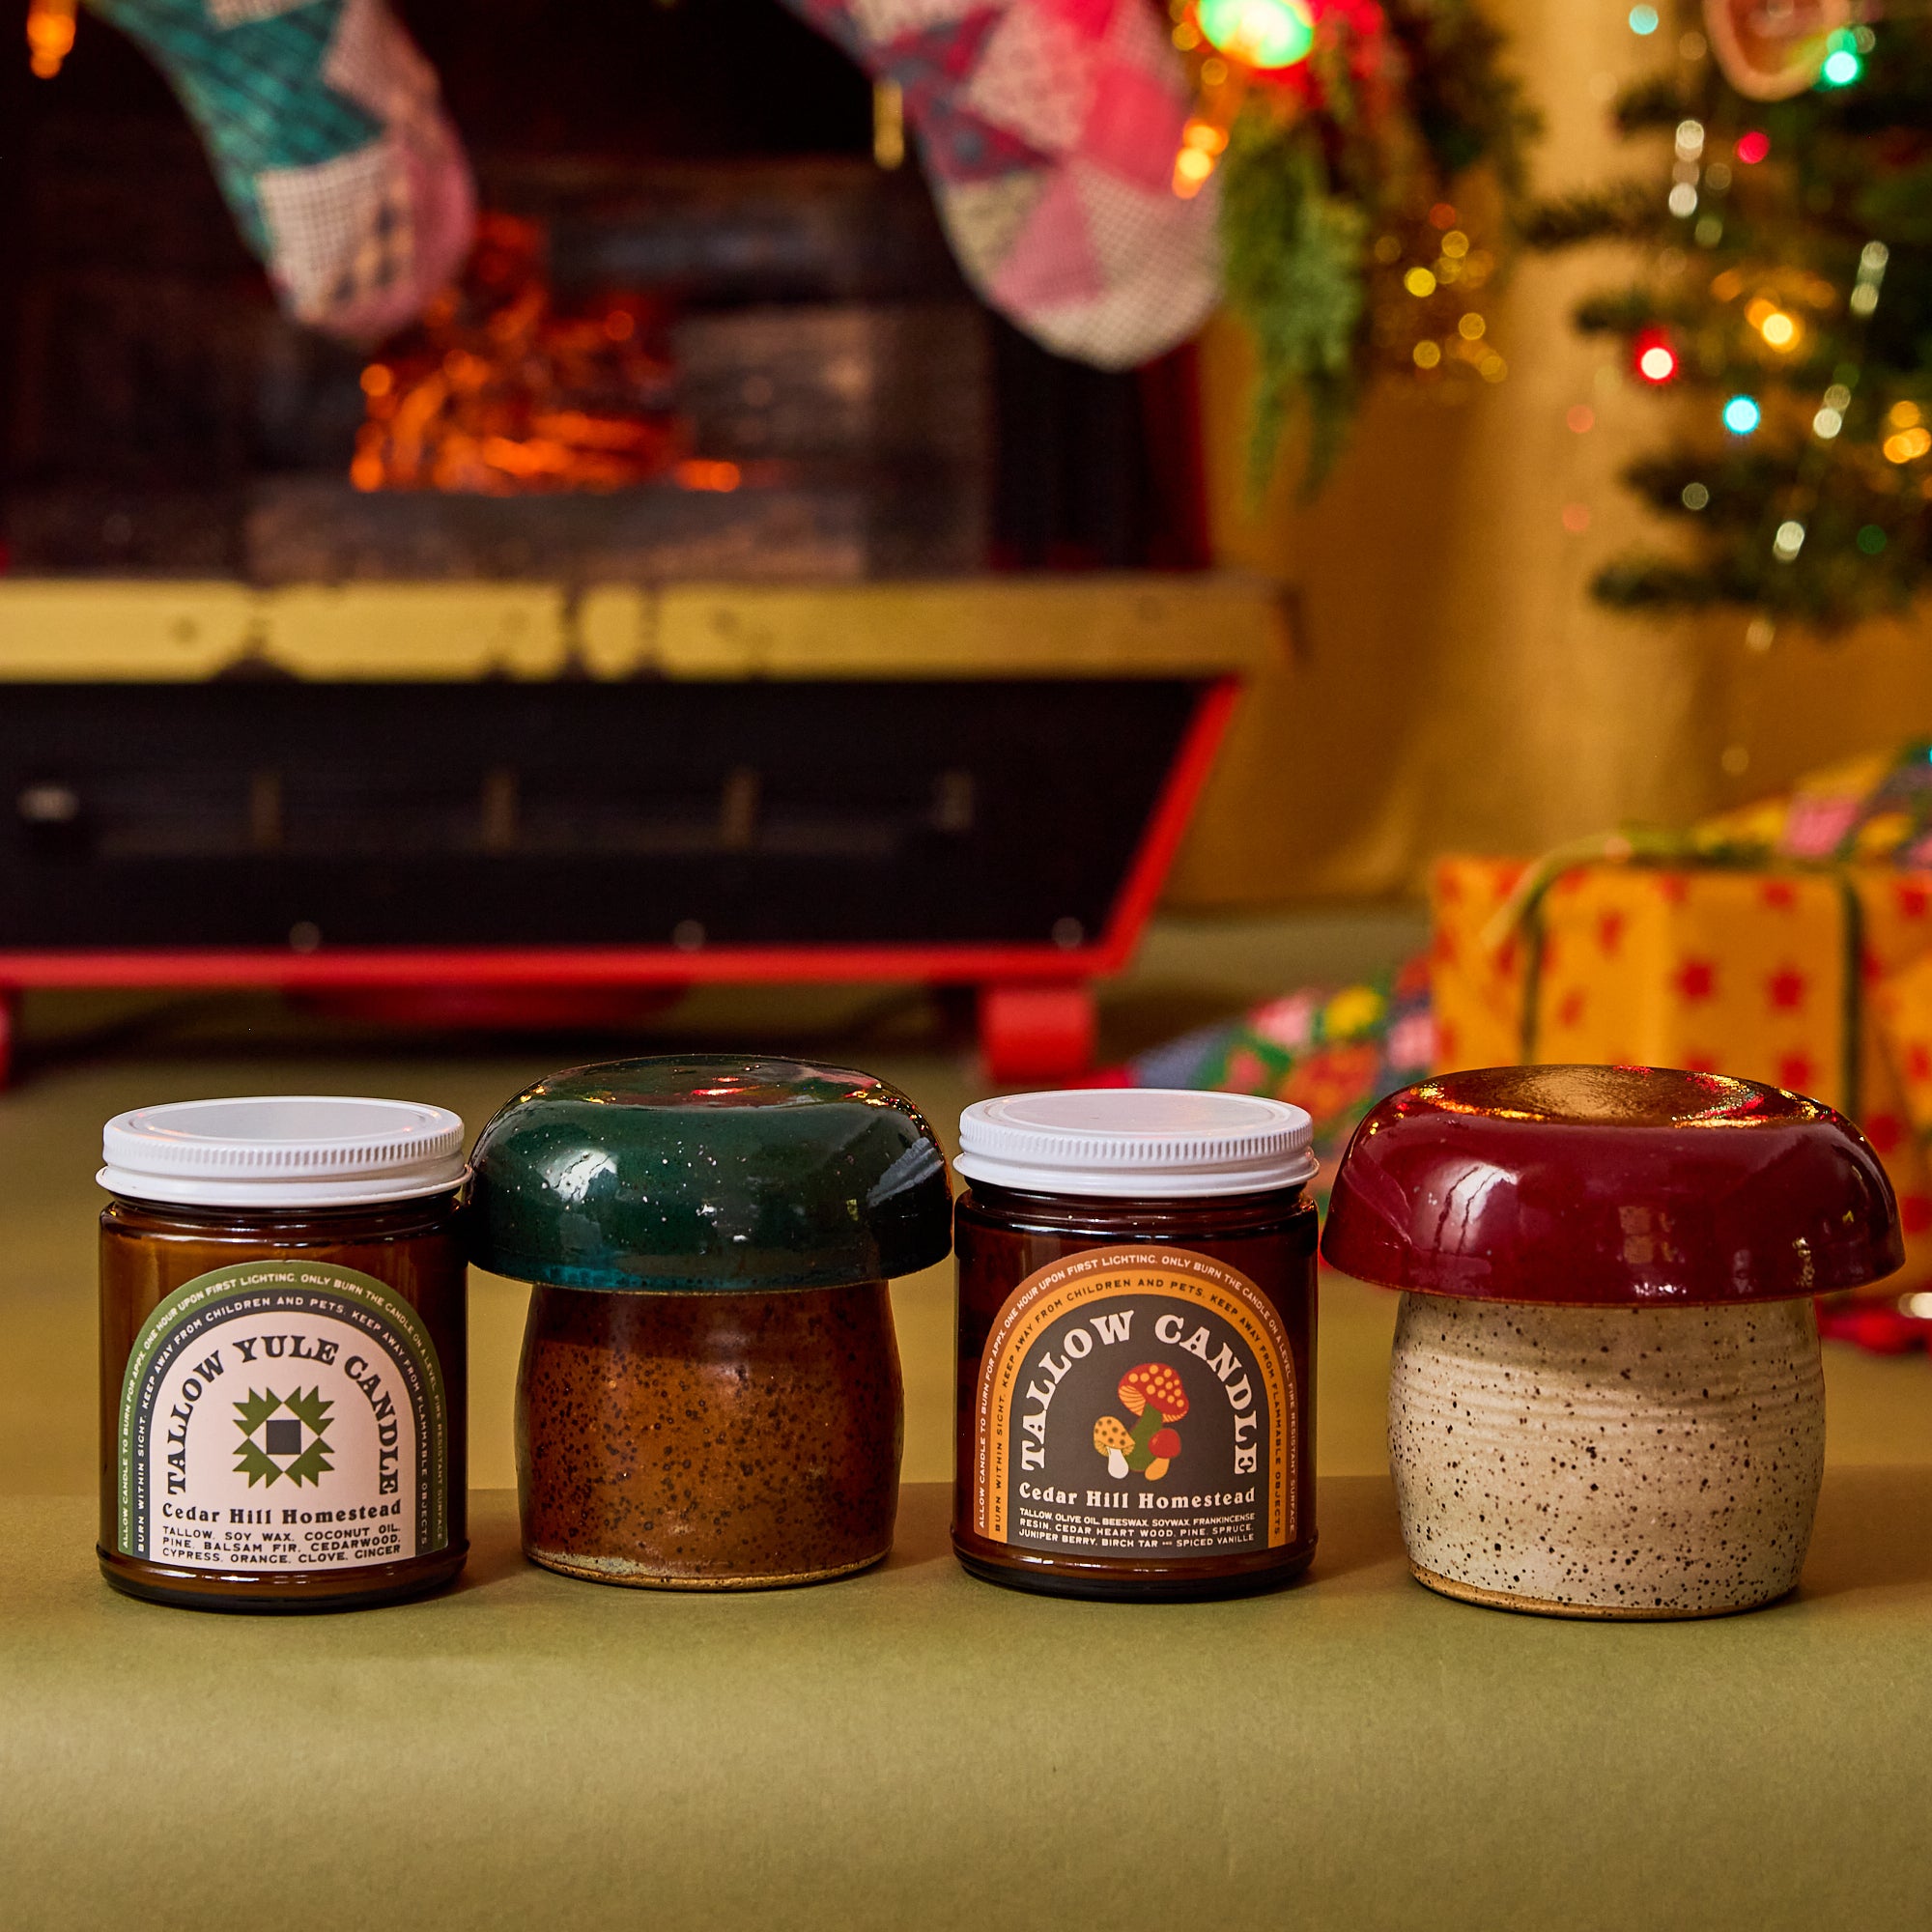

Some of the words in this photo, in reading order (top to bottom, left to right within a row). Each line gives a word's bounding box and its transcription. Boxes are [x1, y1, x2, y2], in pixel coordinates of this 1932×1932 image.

[1067, 1260, 1098, 1276] FIRST
[1161, 1256, 1191, 1268] ONLY
[1193, 1263, 1222, 1279] BURN
[1038, 1270, 1065, 1291] UPON
[1225, 1274, 1242, 1291] THE
[1017, 1286, 1039, 1311] HOUR
[1242, 1288, 1270, 1321] CANDLE
[1004, 1308, 1019, 1328] ONE
[1269, 1320, 1278, 1333] ON
[123, 1439, 128, 1453] TO
[127, 1380, 135, 1402] FOR
[144, 1329, 158, 1350] ONE
[156, 1307, 179, 1331] HOUR
[178, 1291, 205, 1311] UPON
[205, 1279, 237, 1296] FIRST
[300, 1273, 330, 1285] ONLY
[333, 1279, 363, 1295] BURN
[366, 1290, 385, 1306] THE
[385, 1304, 414, 1335] CANDLE
[412, 1334, 422, 1348] ON
[985, 1358, 994, 1380] FOR
[1002, 1355, 1014, 1387] KEEP
[1015, 1323, 1034, 1352] AWAY
[1035, 1298, 1063, 1323] FROM
[1066, 1278, 1131, 1301] CHILDREN
[1138, 1278, 1164, 1287] AND
[1209, 1293, 1238, 1316] KEEP
[1239, 1317, 1260, 1342] AWAY
[1260, 1345, 1274, 1379] FROM
[1271, 1382, 1282, 1464] FLAMMABLE
[142, 1376, 156, 1409] KEEP
[154, 1344, 174, 1374] AWAY
[174, 1319, 203, 1345] FROM
[205, 1297, 270, 1322] CHILDREN
[276, 1296, 303, 1306] AND
[351, 1310, 382, 1331] KEEP
[383, 1331, 405, 1356] AWAY
[404, 1359, 420, 1391] FROM
[417, 1396, 428, 1476] FLAMMABLE
[1021, 1310, 1134, 1471] TALLOW
[1154, 1314, 1257, 1474] CANDLE
[980, 1383, 989, 1415] BURN
[167, 1350, 224, 1495] TALLOW
[232, 1334, 340, 1366] YULE
[344, 1355, 399, 1495] CANDLE
[980, 1418, 986, 1433] TO
[1019, 1482, 1078, 1505] Cedar
[1086, 1490, 1129, 1509] Hill
[1138, 1487, 1255, 1509] Homestead
[162, 1502, 220, 1523] Cedar
[229, 1509, 271, 1524] Hill
[282, 1498, 401, 1524] Homestead
[1055, 1513, 1082, 1523] OLIVE
[1193, 1513, 1255, 1525] FRANKINCENSE
[225, 1531, 251, 1541] SOY
[304, 1527, 370, 1541] COCONUT
[1018, 1528, 1059, 1542] JUNIPER
[1101, 1538, 1134, 1547] BIRCH
[1176, 1538, 1213, 1547] SPICED
[1217, 1533, 1254, 1545] VANILLE
[1055, 1523, 1092, 1535] CEDAR
[1096, 1527, 1134, 1537] HEART
[204, 1541, 262, 1552] BALSAM
[355, 1545, 400, 1559] GINGER
